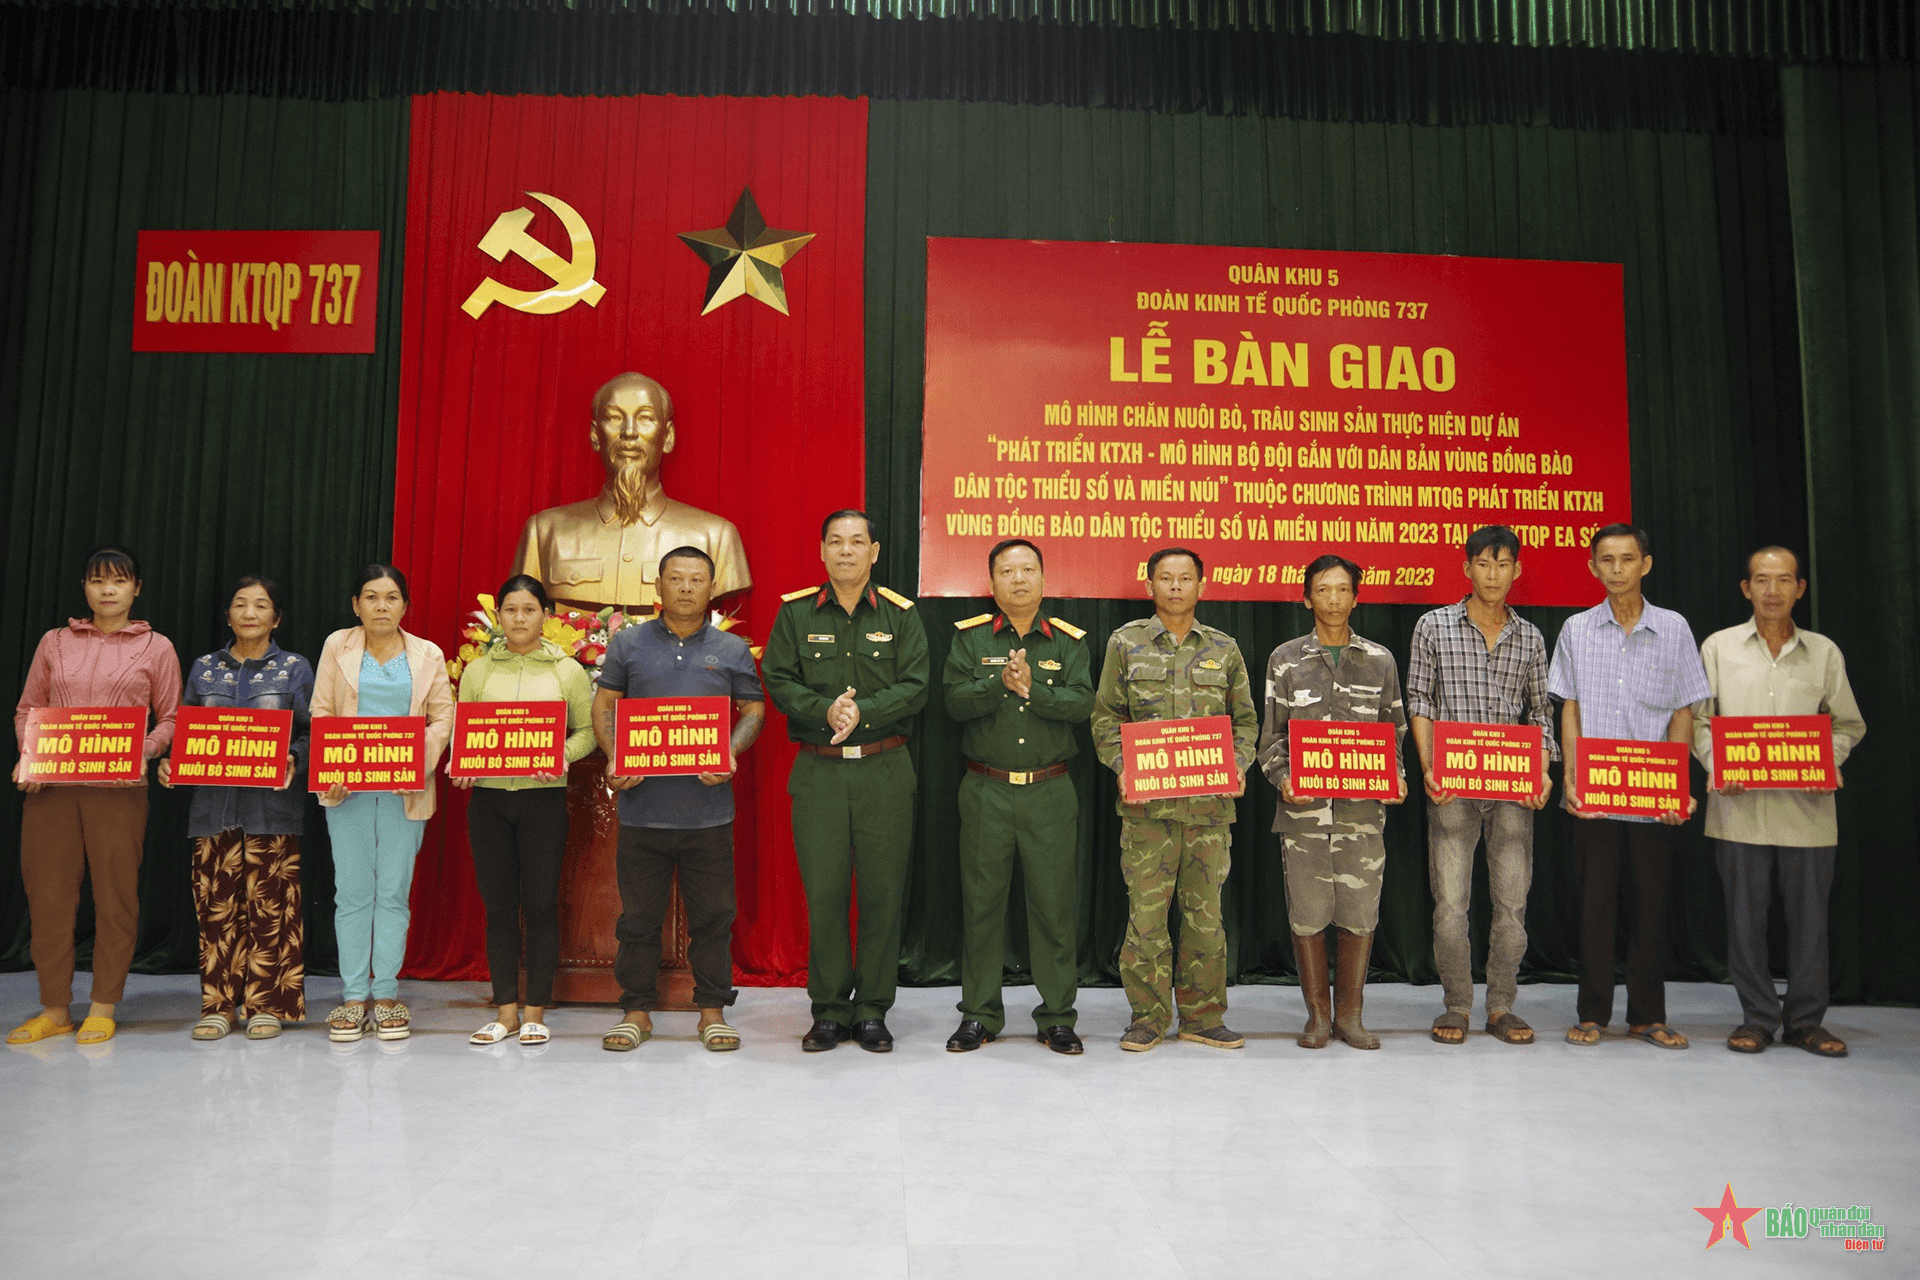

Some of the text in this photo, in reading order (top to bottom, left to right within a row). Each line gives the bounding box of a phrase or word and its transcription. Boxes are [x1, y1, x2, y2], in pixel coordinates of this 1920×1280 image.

[1228, 262, 1339, 287] QUÂN KHU 5
[146, 248, 362, 331] ĐOÀN KTQP 737
[1136, 288, 1428, 320] ĐOÀN KINH TẾ QUỐC PHÒNG 737
[1109, 320, 1456, 392] LỄ BÀN GIAO
[1044, 399, 1519, 441] MÔ HÌNH CHĂN NUÔI BÒ, TRÂU SINH SẢN THỰC HIỆN DỰ ÁN
[987, 432, 1573, 475] “PHÁT TRIỂN KTXH MÔ HÌNH BỘ ĐỘI GẮN VỚI DÂN BẢN VÙNG ĐỒNG BÀO
[953, 469, 1604, 512] DÂN TỘC THIỂU SỐ VÀ MIỀN NÚI” THUỘC CHƯƠNG TRÌNH MTQG PHÁT TRIỂN KTXH
[946, 508, 993, 536] VÙNG
[996, 507, 1045, 537] ĐỒNG
[1050, 510, 1085, 538] BÀO
[1089, 510, 1125, 538] DÂN
[1129, 511, 1162, 540] TỘC
[1166, 508, 1214, 540] THIỂU
[1219, 510, 1243, 540] SỐ
[1246, 514, 1269, 541] VÀ
[1273, 513, 1317, 542] MIỀN
[1321, 515, 1351, 542] NÚI
[1355, 516, 1394, 543] NĂM
[1398, 521, 1438, 544] 2023
[1442, 522, 1466, 546] TẠI
[1511, 524, 1550, 548] TQP
[1554, 525, 1576, 547] EA
[1212, 563, 1252, 585] ngày
[1258, 564, 1277, 584] 18
[1281, 564, 1306, 584] thá
[1394, 567, 1435, 586] 2023
[36, 733, 132, 754] MÔ HÌNH
[185, 734, 277, 758] MÔ HÌNH
[465, 727, 554, 749] MÔ HÌNH
[629, 724, 718, 747] MÔ HÌNH
[323, 742, 413, 764] MÔ HÌNH
[459, 752, 555, 769] NUÔI BÒ SINH SẢN
[624, 749, 721, 768] NUÔI BÒ SINH SẢN
[1136, 745, 1224, 771] MÔ HÌNH
[1302, 747, 1386, 771] MÔ HÌNH
[1445, 749, 1530, 773] MÔ HÌNH
[1725, 741, 1820, 762] MÔ HÌNH
[29, 757, 132, 773] NUÔI BÒ SINH SẢN
[178, 761, 277, 779] NUÔI BÒ SINH SẢN
[318, 766, 416, 785] NUÔI BÒ SINH SẢN
[1722, 765, 1825, 783] NUÔI BÒ SINH SẢN
[1133, 769, 1229, 792] NUÔI BÒ SINH SẢN
[1298, 774, 1389, 791] NUÔI BÒ SINH SẢN
[1441, 774, 1533, 793] NUÔI BÒ SINH SẢN
[1588, 765, 1677, 790] MÔ HÌNH
[1584, 791, 1680, 812] NUÔI BÒ SINH SẢN
